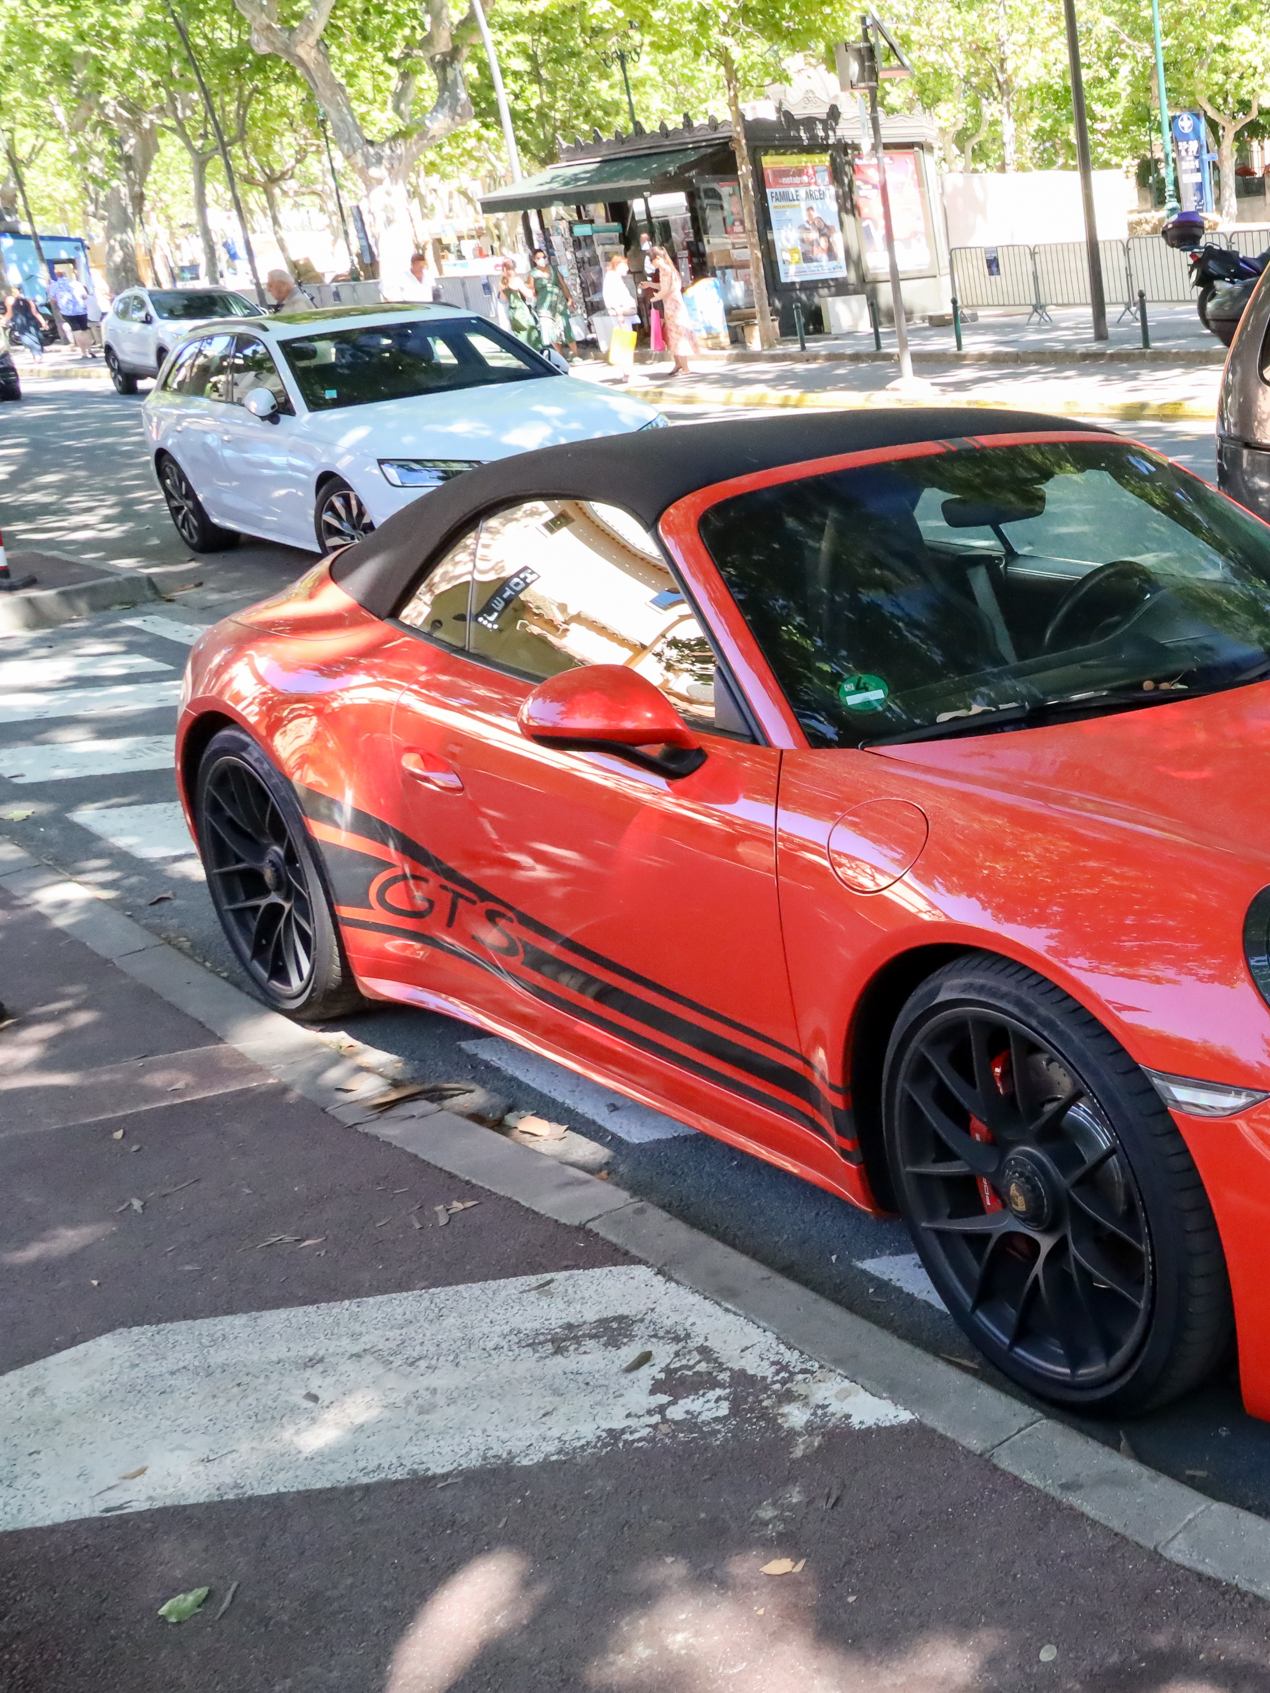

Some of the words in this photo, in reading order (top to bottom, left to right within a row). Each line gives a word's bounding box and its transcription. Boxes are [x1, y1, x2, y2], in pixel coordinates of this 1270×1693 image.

[770, 190, 800, 203] FAMILLE
[855, 676, 869, 692] 4
[376, 874, 526, 957] GTS
